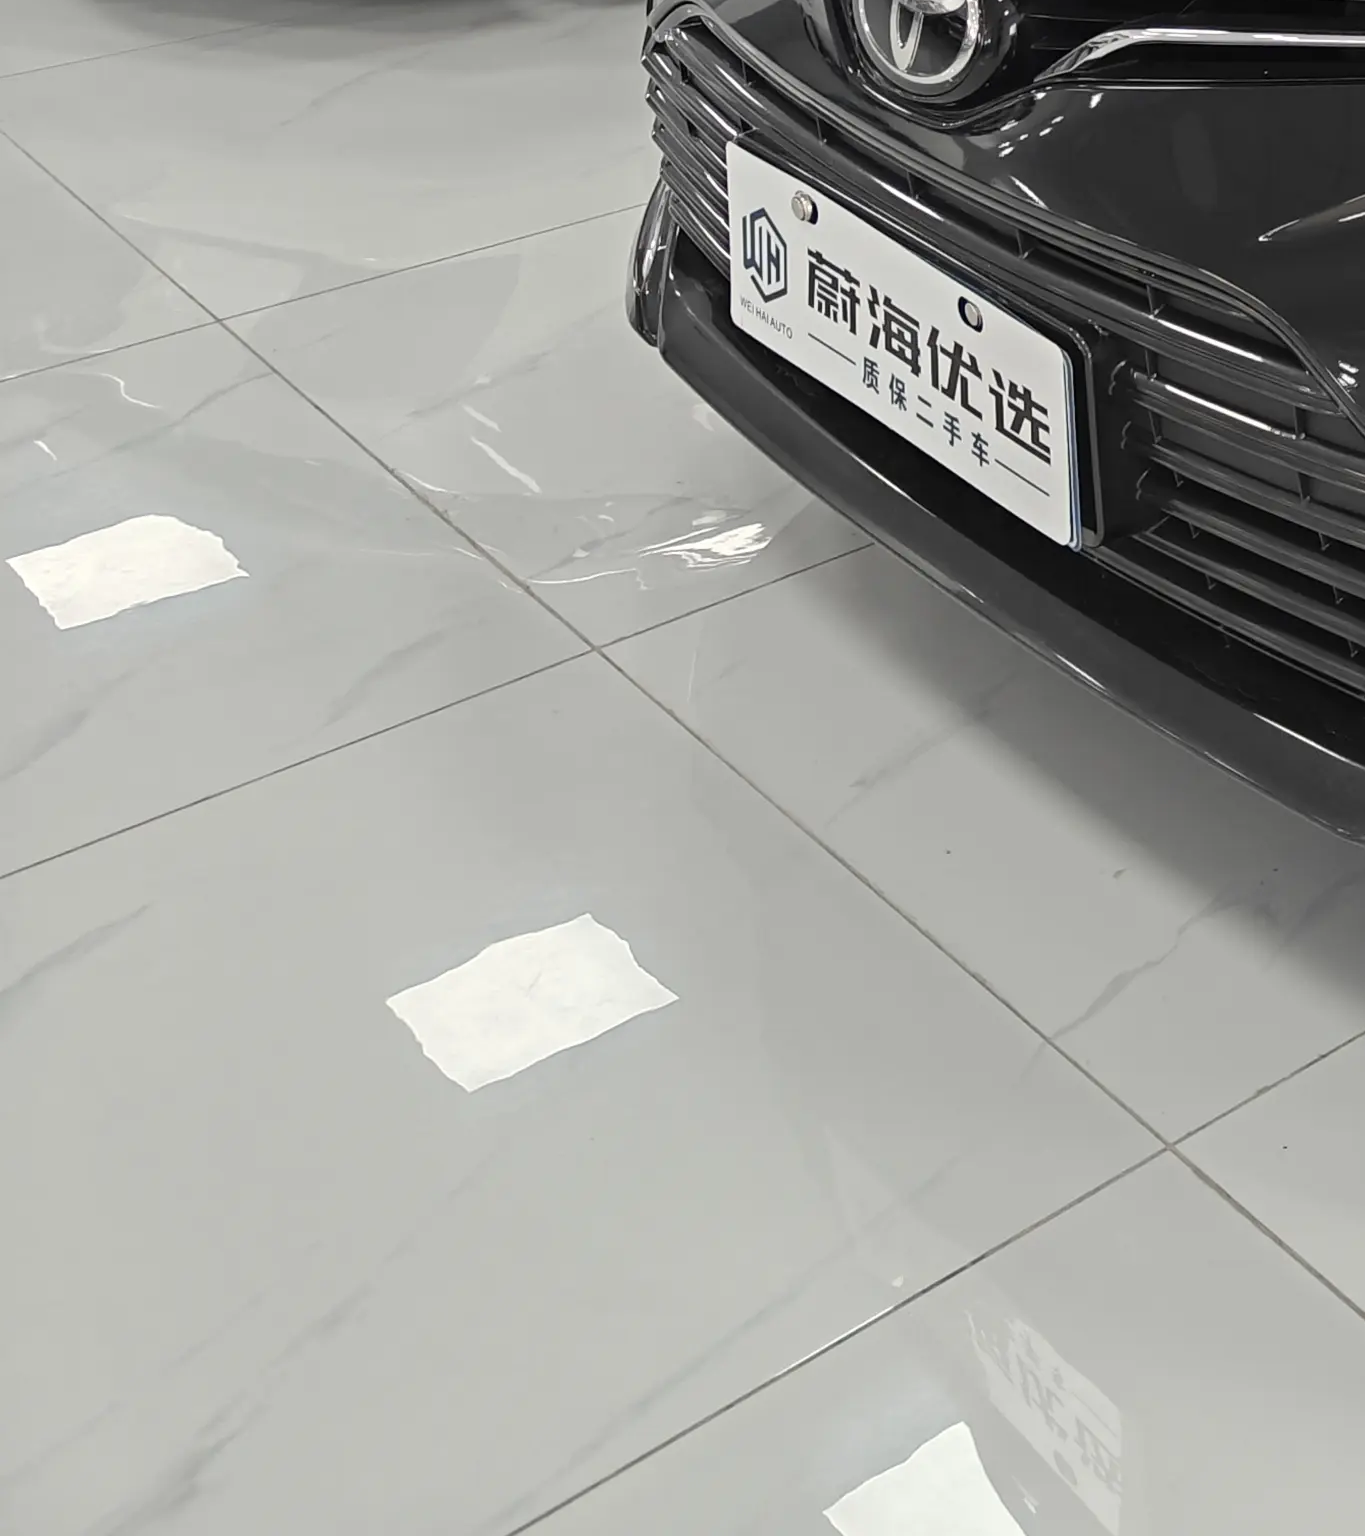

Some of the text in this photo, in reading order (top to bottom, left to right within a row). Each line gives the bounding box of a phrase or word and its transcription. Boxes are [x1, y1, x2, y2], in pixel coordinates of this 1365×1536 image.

[740, 295, 793, 339] WEI HAI AUTO
[807, 247, 1051, 466] 蔚海优选
[862, 356, 991, 468] 质保二手车
